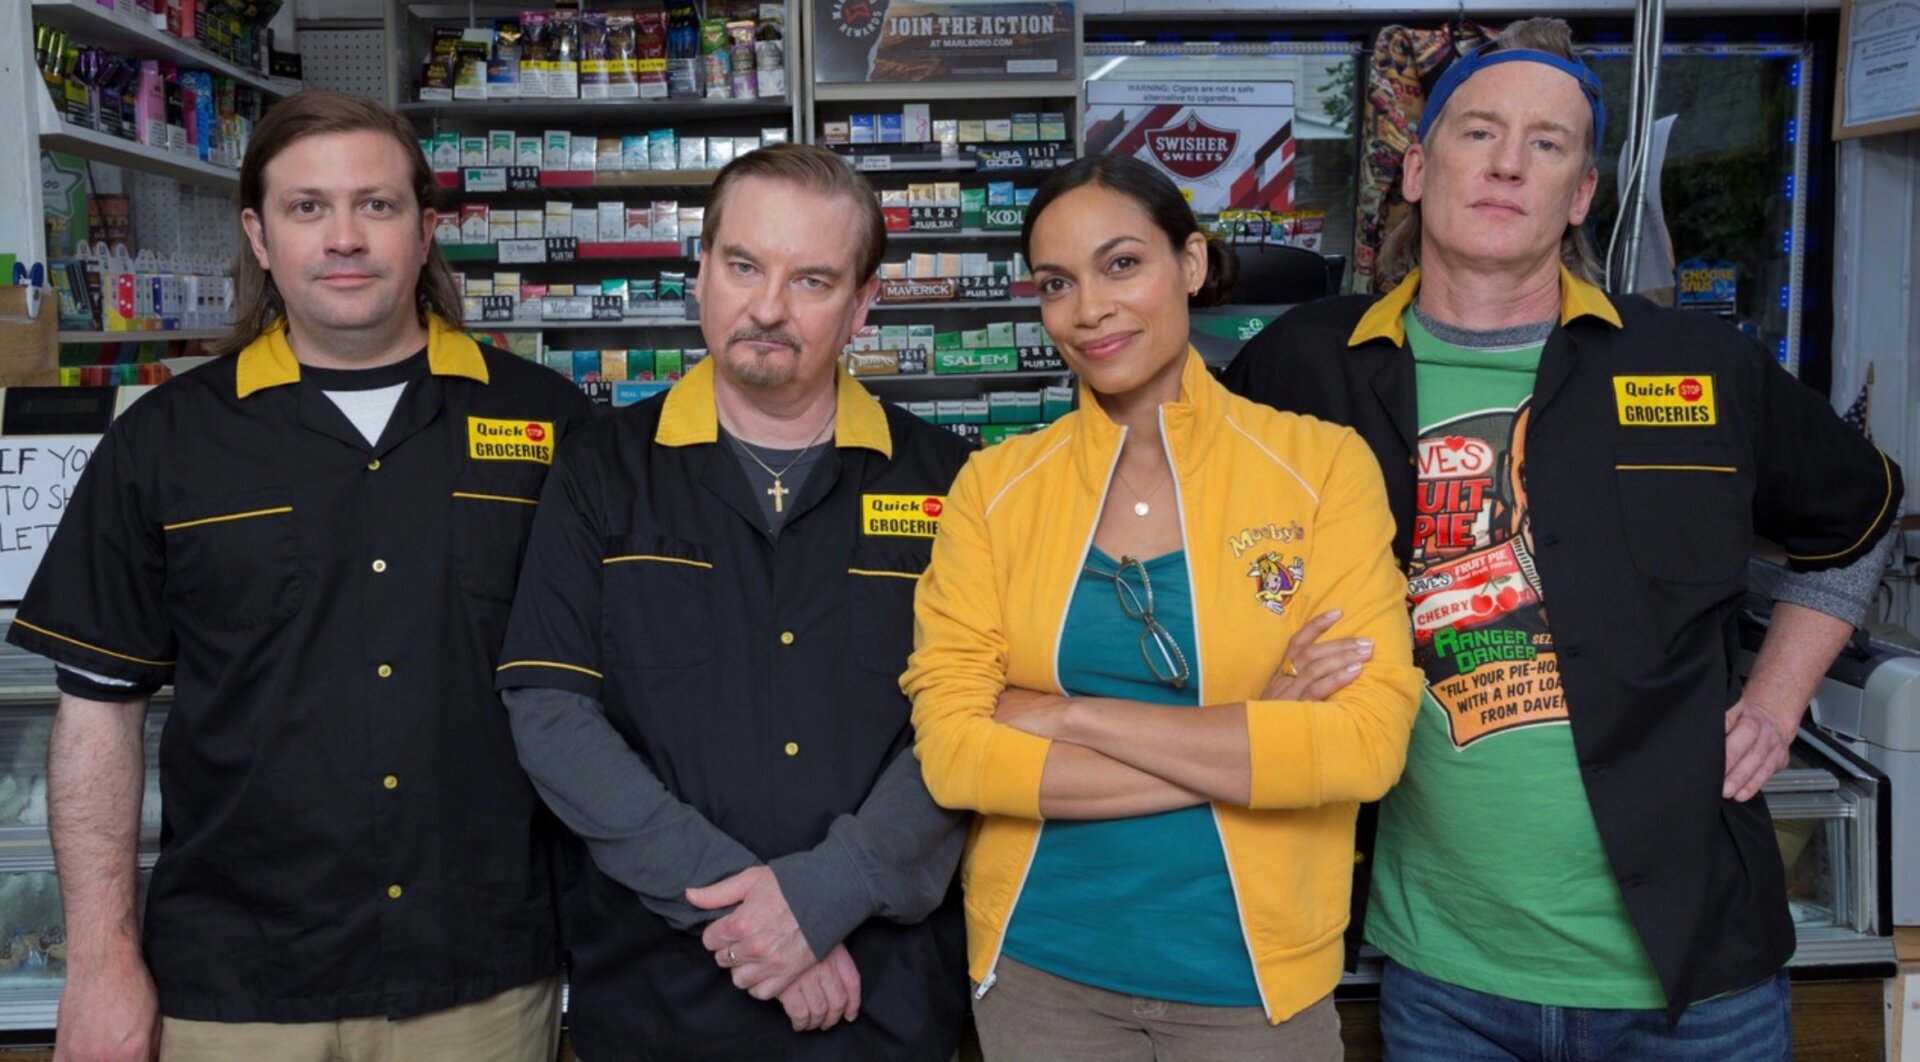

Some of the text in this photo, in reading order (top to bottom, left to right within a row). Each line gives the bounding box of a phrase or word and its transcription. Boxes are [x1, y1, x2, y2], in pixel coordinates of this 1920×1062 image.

[839, 11, 882, 37] REWARDS
[889, 15, 1055, 36] JOIN THE ACTION
[930, 38, 1013, 48] AT MARLBORO.COM
[1172, 84, 1199, 94] Cigars
[1201, 85, 1214, 93] are
[1215, 85, 1229, 93] not
[1238, 84, 1255, 93] safe
[1187, 94, 1196, 102] to
[1156, 137, 1228, 151] SWISHER
[992, 150, 1021, 159] USA
[1162, 152, 1224, 162] SWEETS
[986, 159, 1024, 167] GOLD
[915, 219, 955, 230] PLUS TAX
[986, 209, 1024, 225] KOOL
[886, 285, 950, 297] MAVERICK
[965, 289, 1006, 298] PLUS TAX
[941, 353, 1010, 366] SALEM
[1023, 359, 1062, 368] PLUS TAX
[1625, 382, 1701, 397] Quick STOP
[1625, 405, 1710, 423] GROCERIES
[477, 422, 523, 437] Quick
[476, 442, 550, 461] GROCERIES
[0, 445, 93, 479] IF YO
[0, 484, 39, 516] TO
[872, 499, 920, 512] Quick
[869, 518, 940, 535] GROCERIE
[1412, 513, 1477, 548] PIE
[1454, 549, 1508, 577] FRUIT PIE
[1416, 601, 1470, 627] CHERRY
[1433, 626, 1528, 658] RANGER
[1455, 645, 1537, 676] DANGER
[1472, 668, 1505, 689] YOUR
[1457, 692, 1488, 715] WITH
[1493, 688, 1503, 702] A
[1507, 681, 1534, 698] HOT
[1480, 702, 1518, 726] FROM
